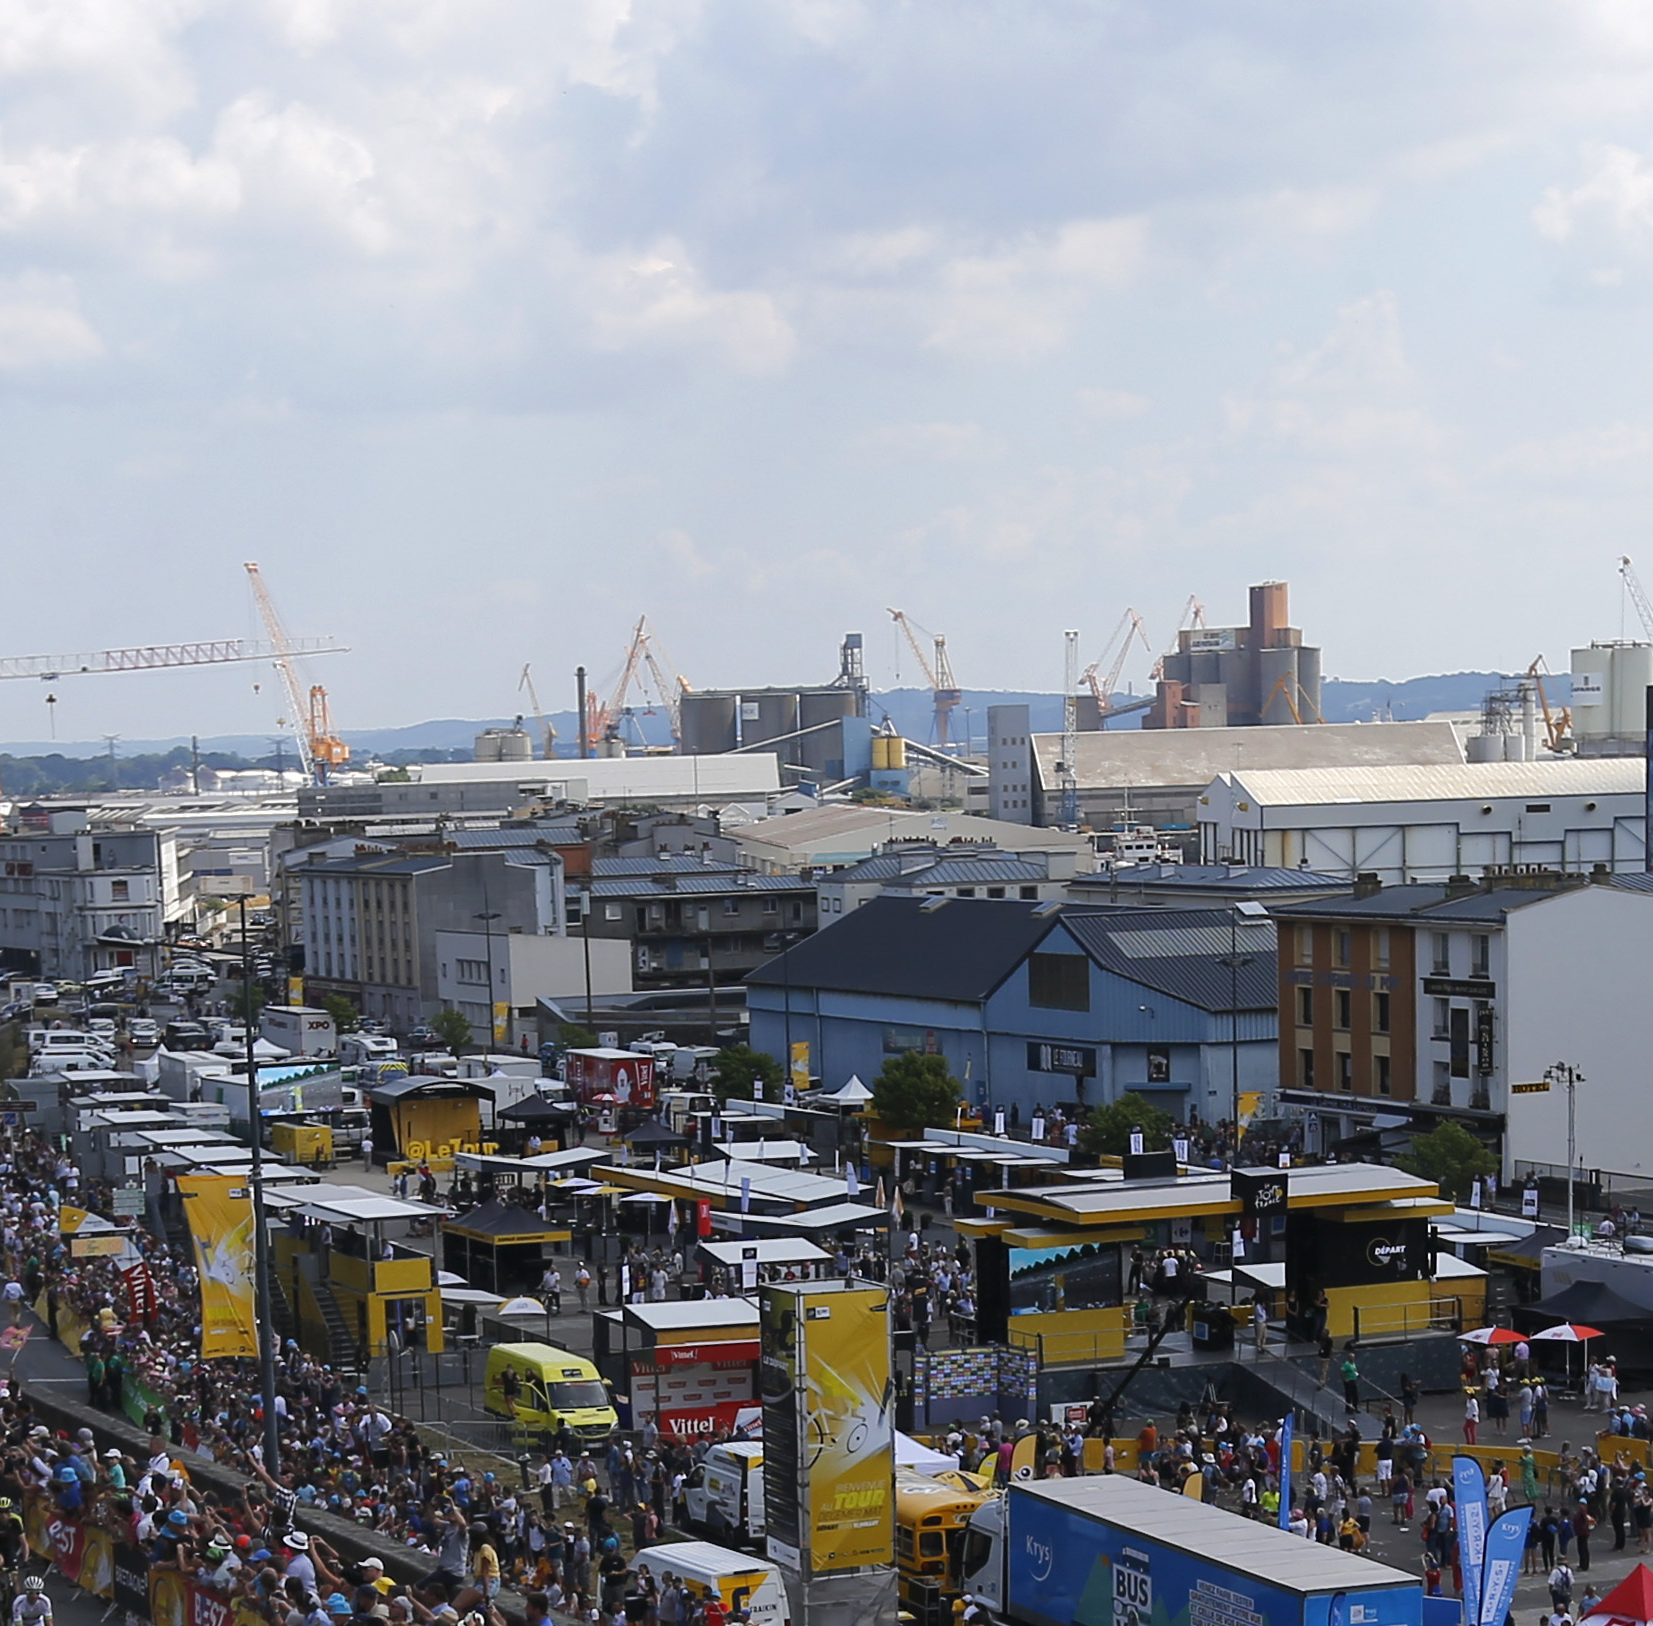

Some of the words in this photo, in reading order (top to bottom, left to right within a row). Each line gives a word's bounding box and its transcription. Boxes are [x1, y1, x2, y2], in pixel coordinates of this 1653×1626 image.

[308, 1021, 330, 1030] XPO
[1512, 1083, 1549, 1093] HOTEL
[669, 1416, 715, 1434] Vittel
[835, 1489, 885, 1510] TOUR
[1026, 1534, 1051, 1565] Krys
[115, 1564, 146, 1596] BRETAGNE
[1116, 1568, 1148, 1607] BUS
